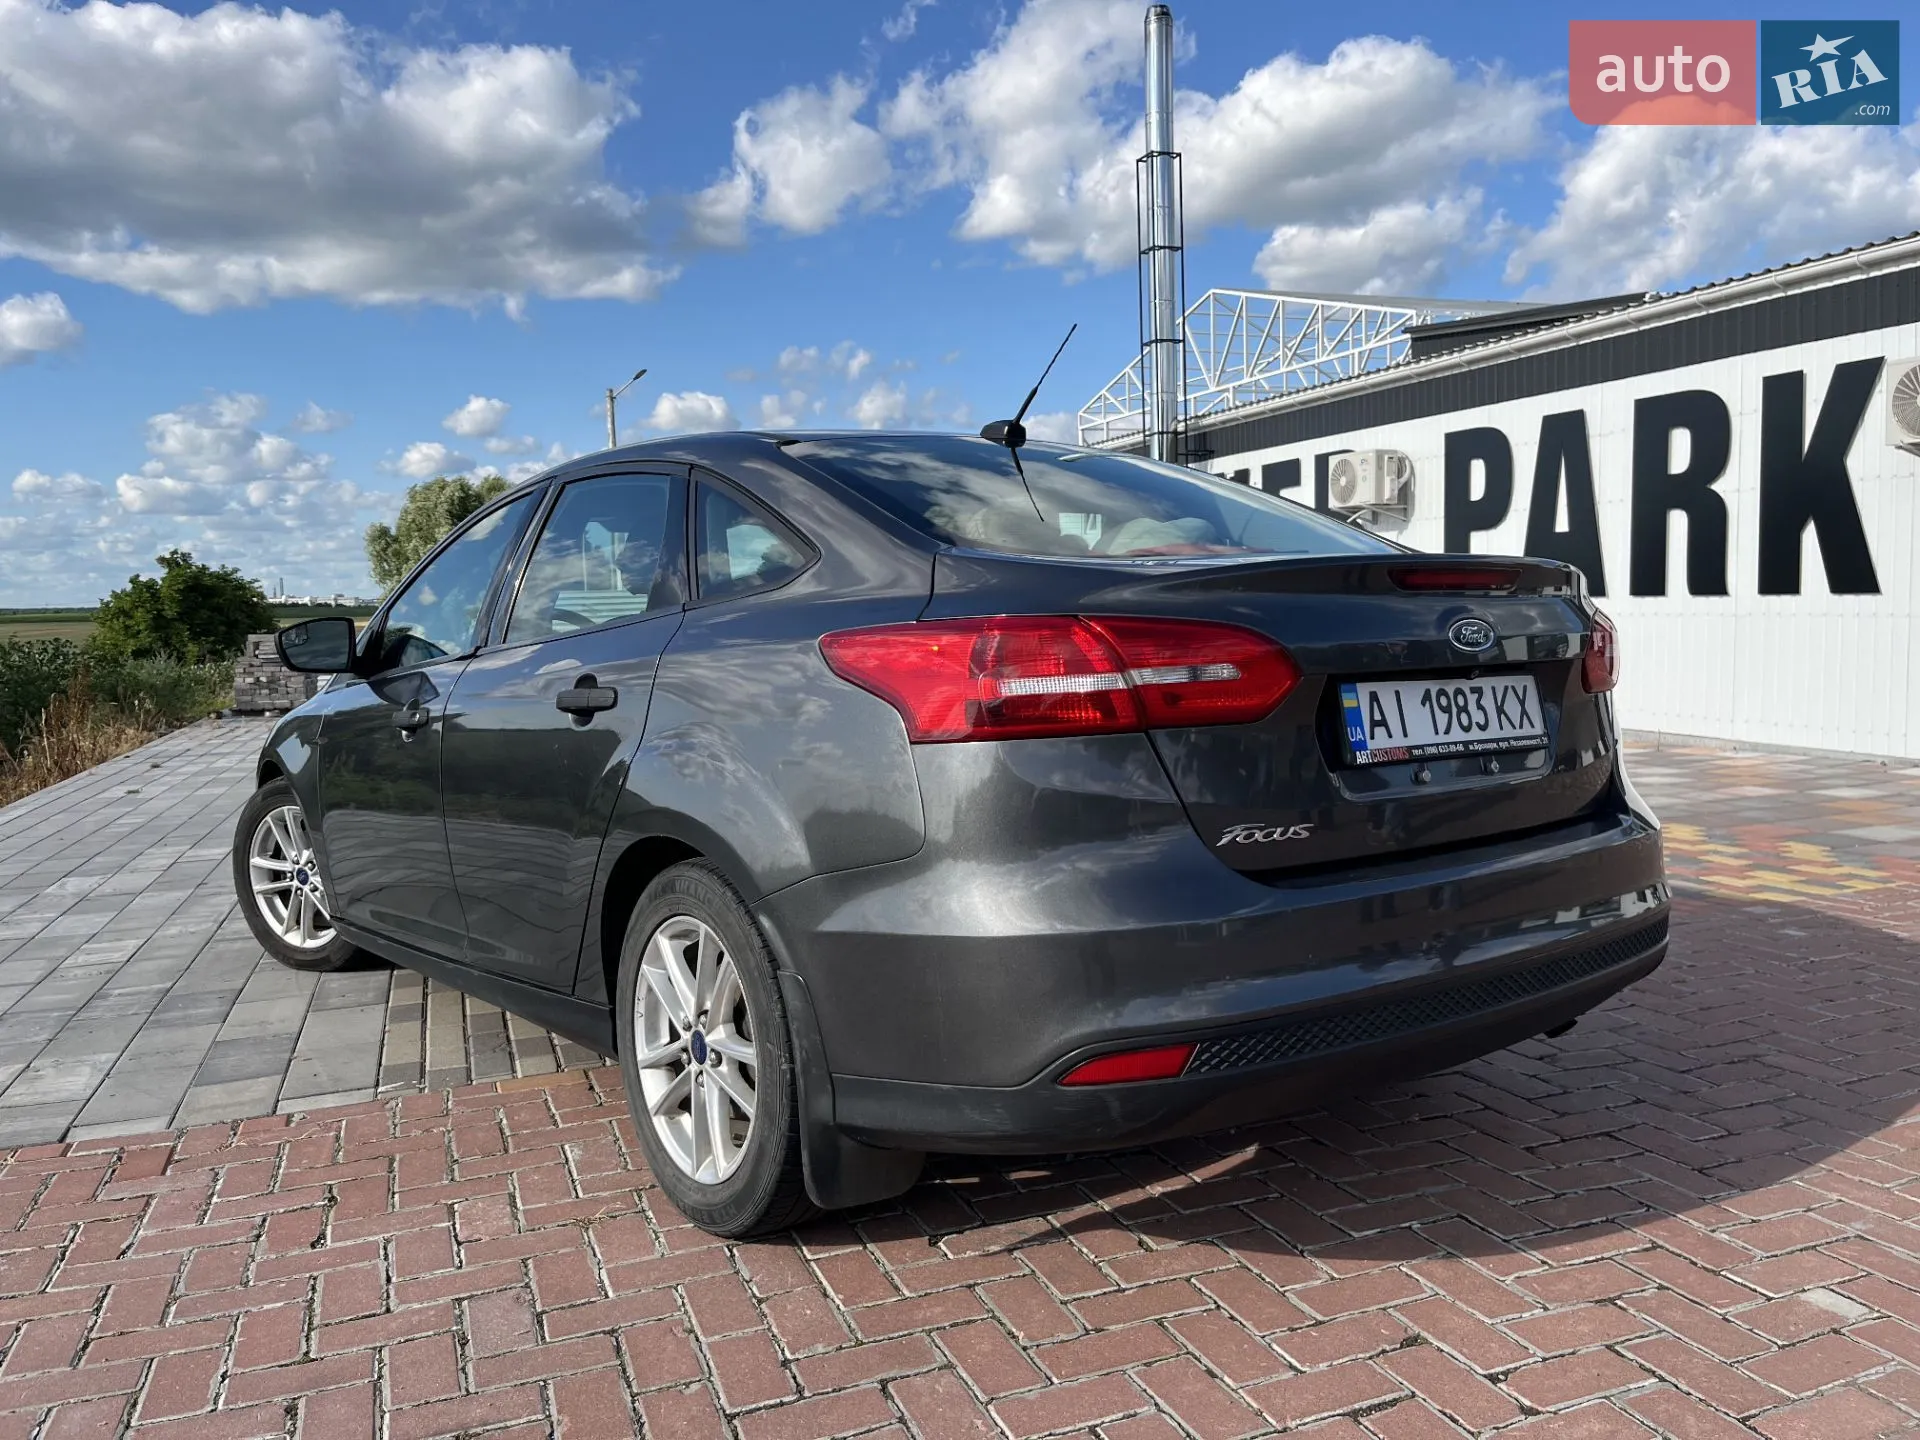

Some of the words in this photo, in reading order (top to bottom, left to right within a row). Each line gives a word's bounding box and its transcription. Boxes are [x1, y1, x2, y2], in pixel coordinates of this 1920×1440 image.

[1444, 356, 1888, 597] PARK
[1460, 626, 1486, 643] Ford
[1369, 689, 1408, 740] AI
[1421, 686, 1490, 736] 1983
[1491, 684, 1535, 731] KX
[1347, 727, 1364, 742] UA
